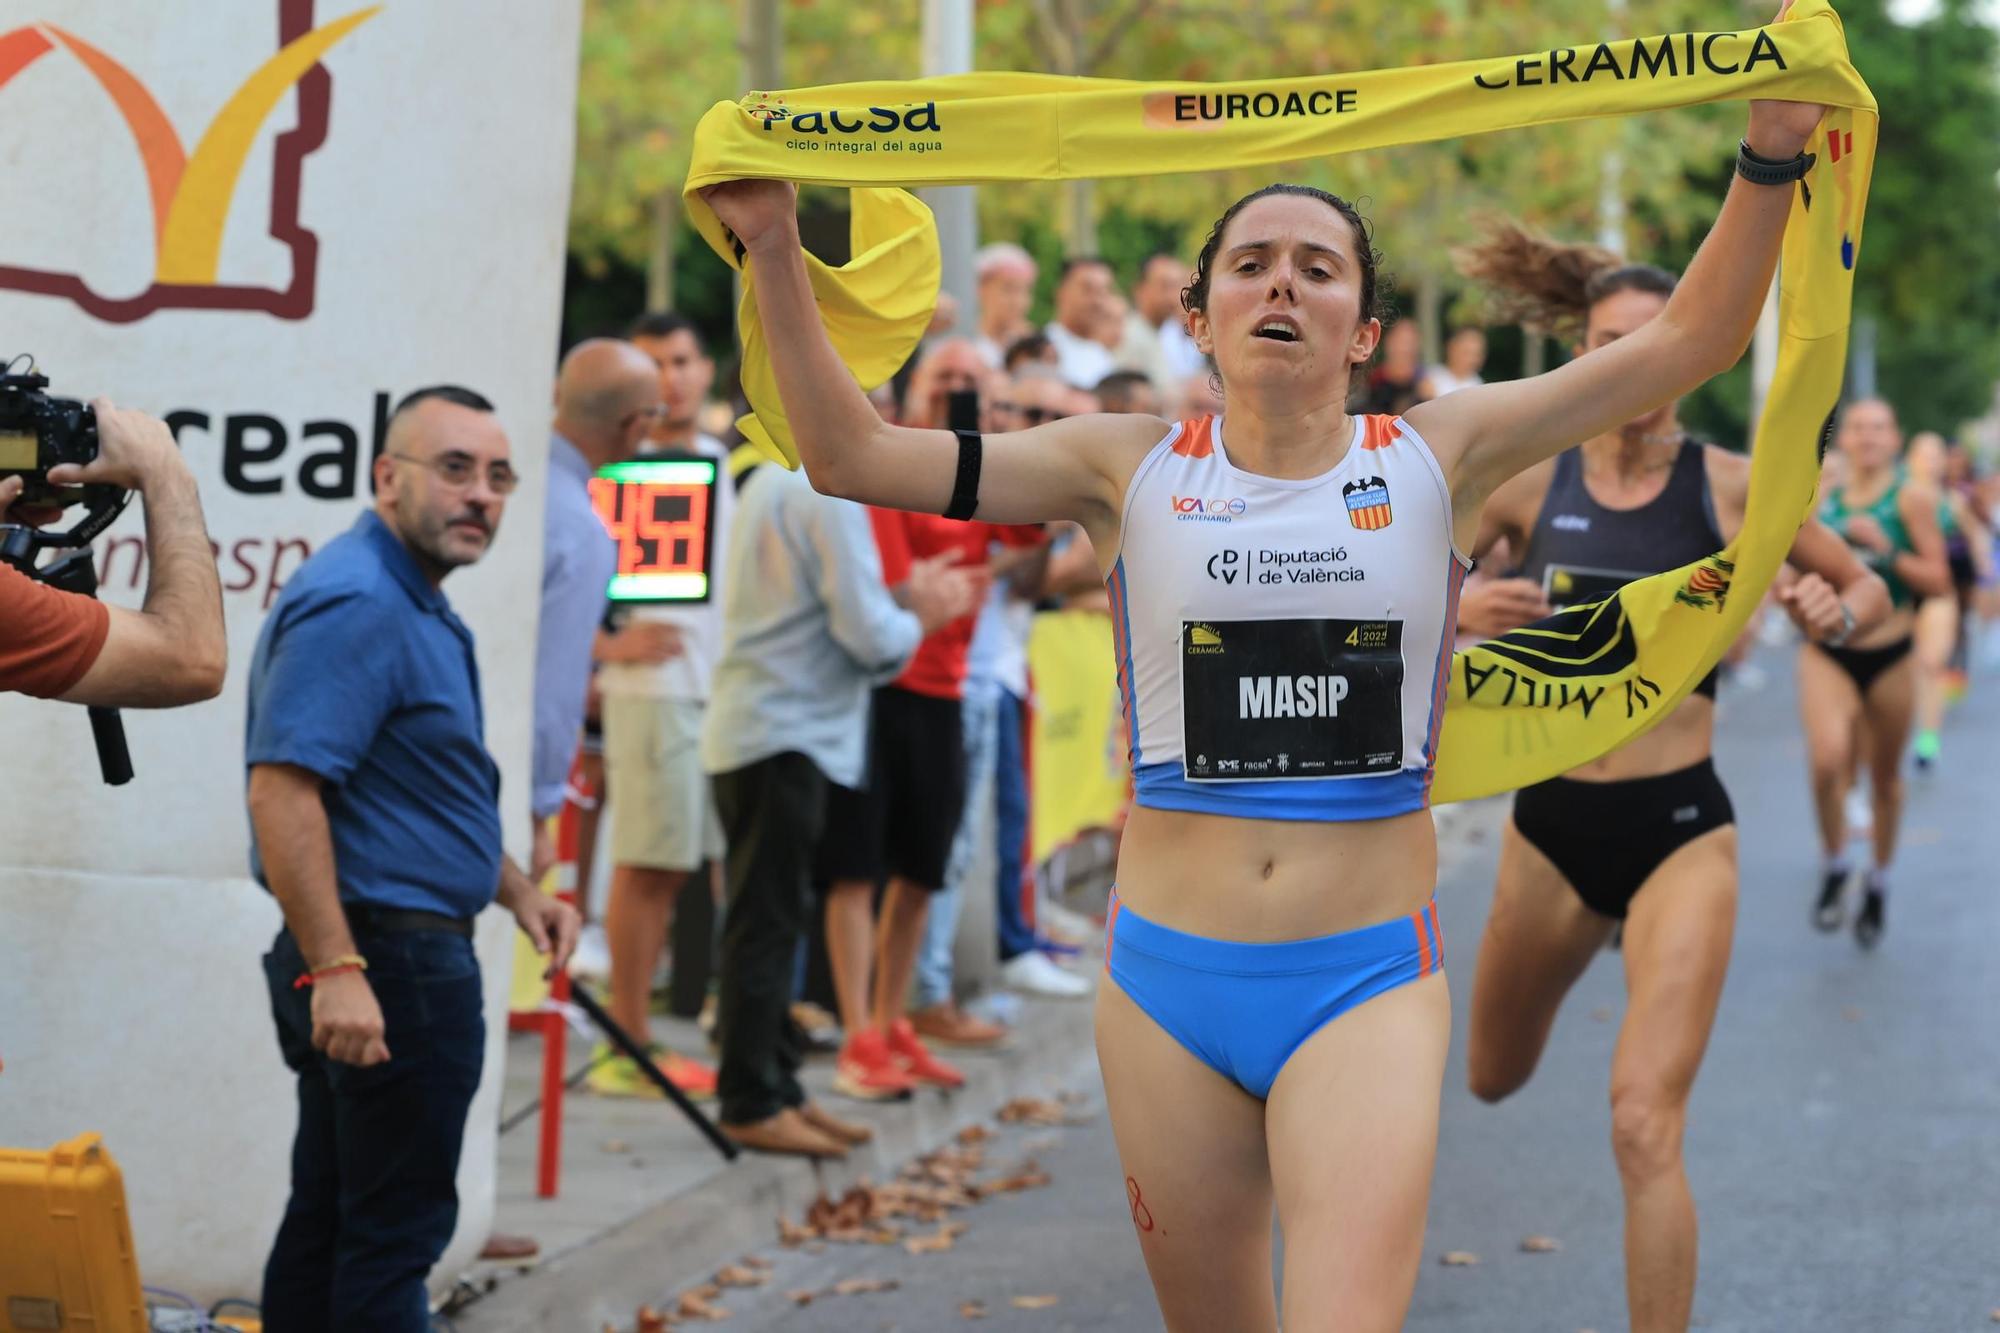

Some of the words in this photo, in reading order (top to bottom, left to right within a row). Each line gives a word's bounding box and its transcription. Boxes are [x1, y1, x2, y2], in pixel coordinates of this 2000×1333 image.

[1175, 89, 1358, 121] EUROACE
[786, 139, 819, 151] ciclo
[824, 140, 877, 153] integral
[882, 140, 903, 151] del
[908, 142, 942, 154] agua
[1177, 513, 1232, 523] CENTENARIO
[1259, 546, 1348, 567] Diputació
[1258, 569, 1283, 584] de
[1287, 566, 1366, 584] València
[1344, 625, 1360, 646] 4
[1239, 675, 1349, 719] MASIP
[1464, 655, 1605, 720] MILLA
[1126, 1175, 1154, 1232] 8
